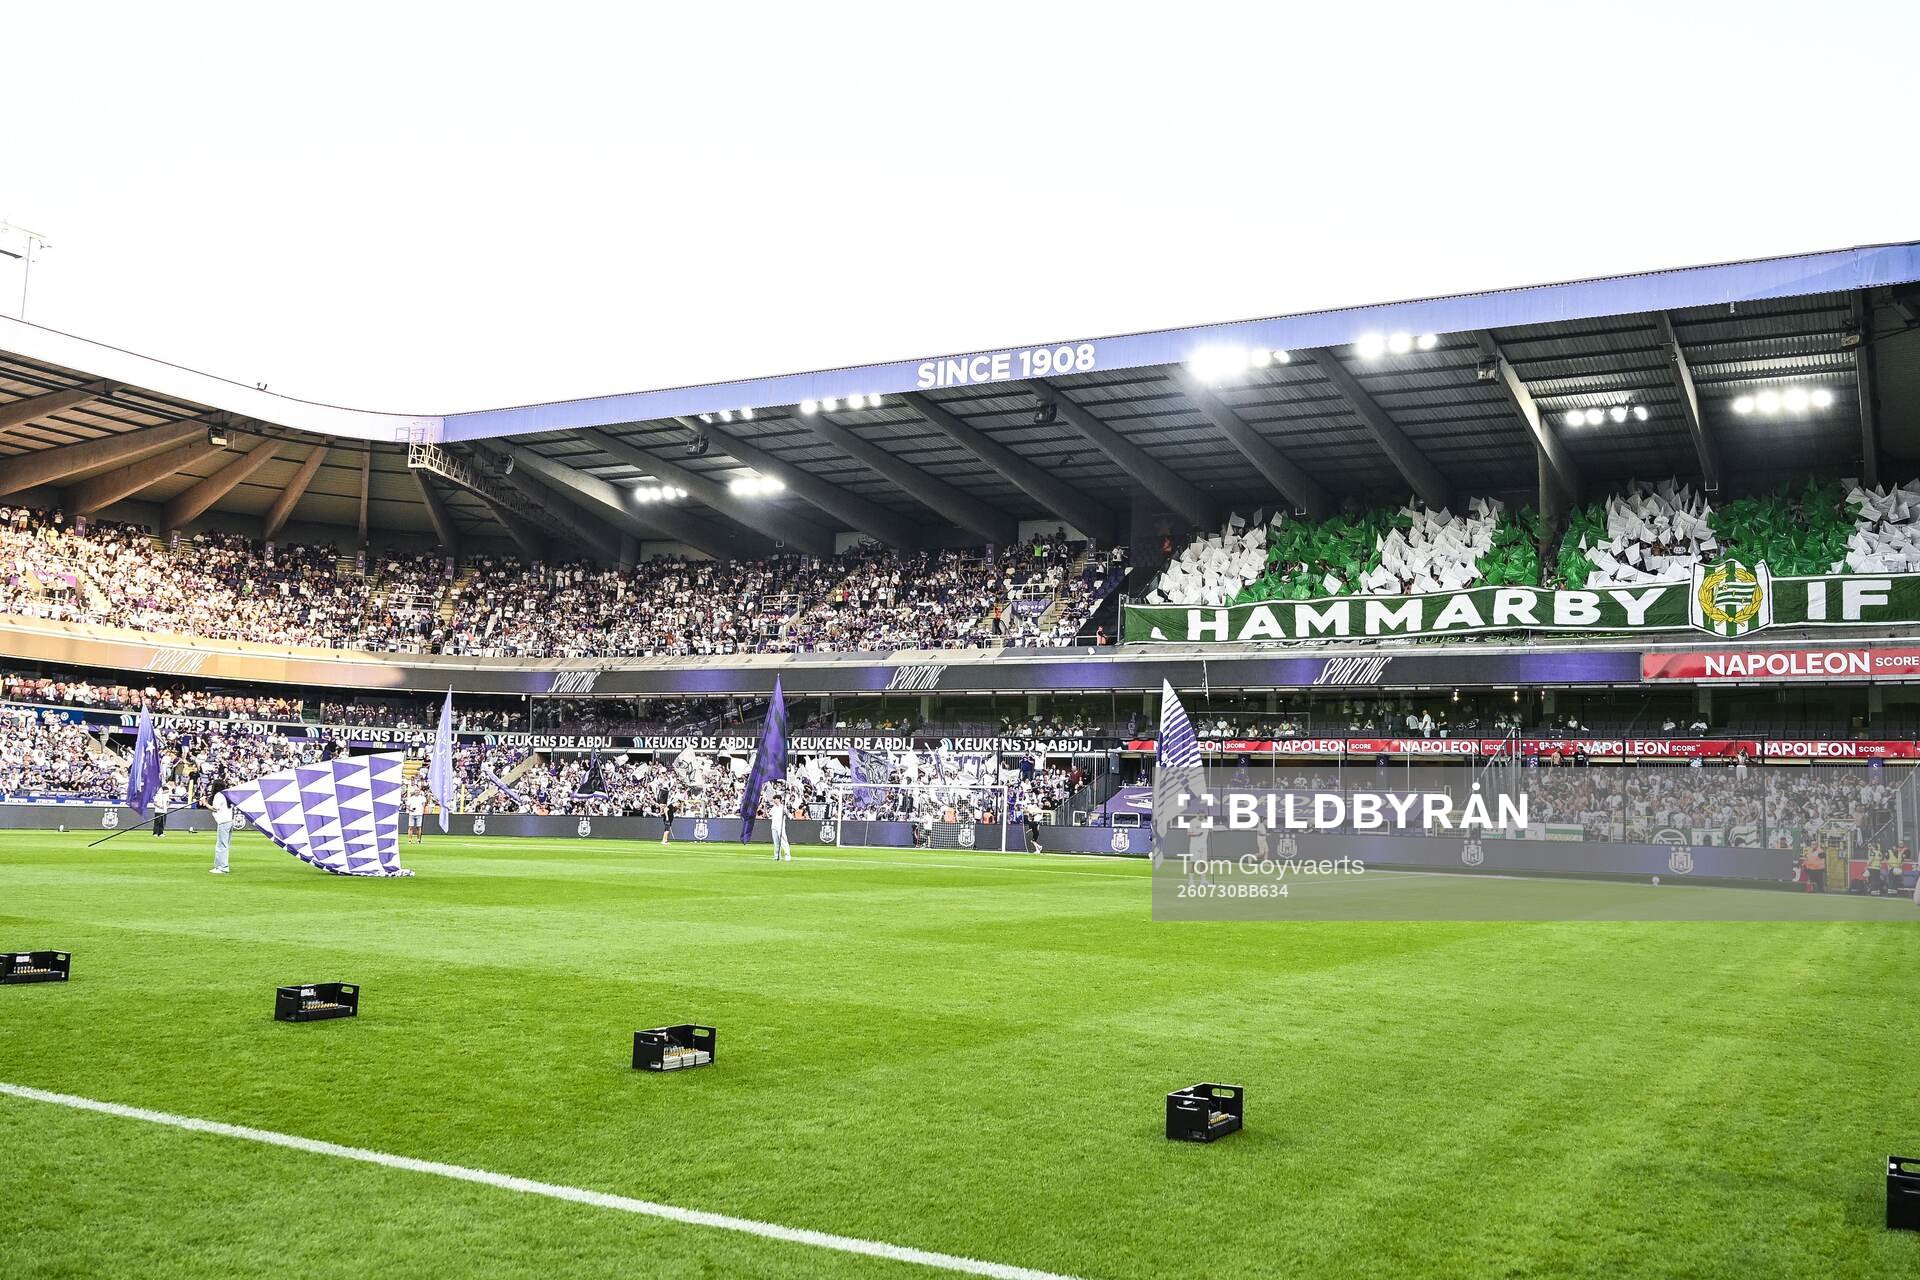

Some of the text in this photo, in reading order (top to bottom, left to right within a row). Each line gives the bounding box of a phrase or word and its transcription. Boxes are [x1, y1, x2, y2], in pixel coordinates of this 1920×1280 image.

[917, 344, 1096, 388] SINCE 1908
[1187, 579, 1892, 642] HAMMARBY IF
[1313, 656, 1393, 684] SPORTING
[1704, 651, 1920, 676] NAPOLEON SCORE
[547, 671, 601, 693] SPORTING
[885, 665, 948, 690] SPORTING
[322, 727, 391, 742] EUKENS
[394, 730, 412, 743] DE
[498, 735, 612, 748] KEUKENS DE ABDIJ
[645, 736, 755, 749] KEUKENS DE ABDIJ
[791, 737, 914, 750] KEUKENS DE ABDIJ
[955, 738, 1021, 751] KEUKENS
[1049, 739, 1092, 752] ABDIJ
[1272, 740, 1345, 752] NAPOLEON
[1400, 741, 1479, 753] NAPOLEON
[1756, 742, 1856, 756] NAPOLEON
